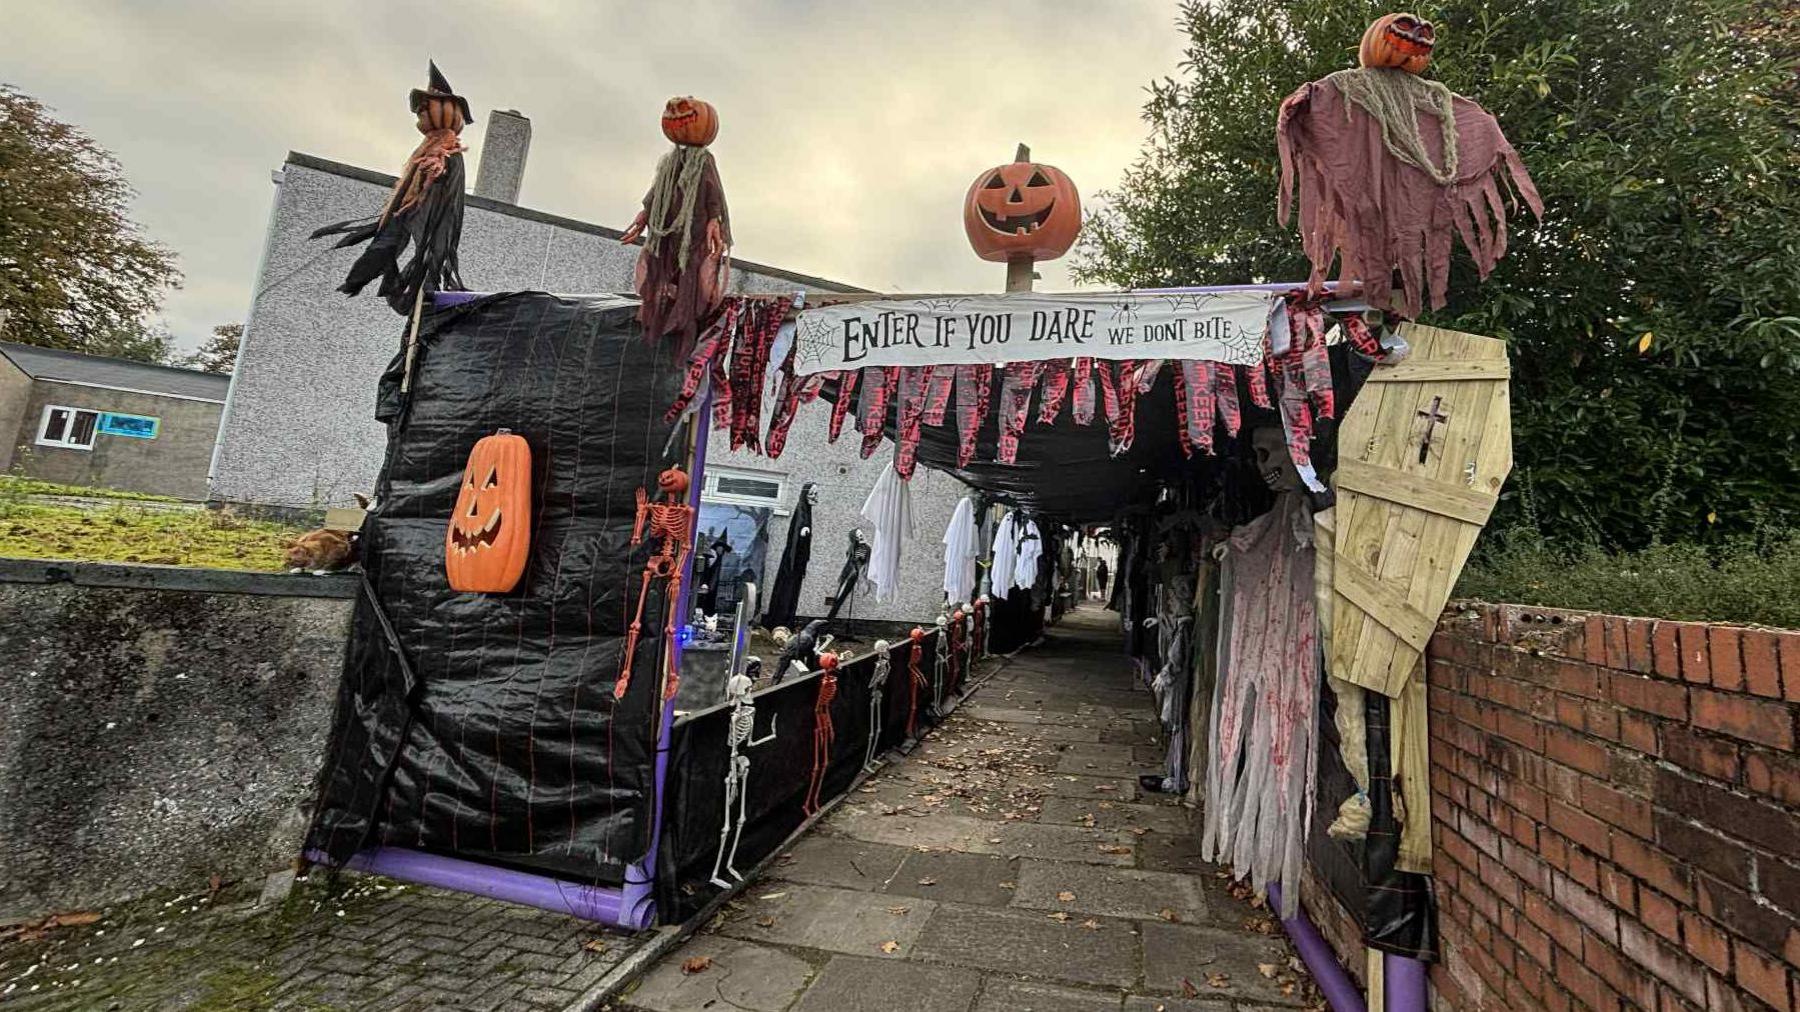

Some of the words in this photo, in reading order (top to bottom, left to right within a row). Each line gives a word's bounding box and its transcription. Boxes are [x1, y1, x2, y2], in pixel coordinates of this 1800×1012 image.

[842, 311, 927, 362] ENTER
[931, 315, 957, 347] IF
[965, 312, 1013, 350] YOU
[1028, 307, 1097, 343] DARE
[1107, 326, 1135, 345] WE
[1143, 318, 1188, 343] DONT
[1193, 316, 1232, 340] BITE
[1191, 383, 1212, 431] KEEP
